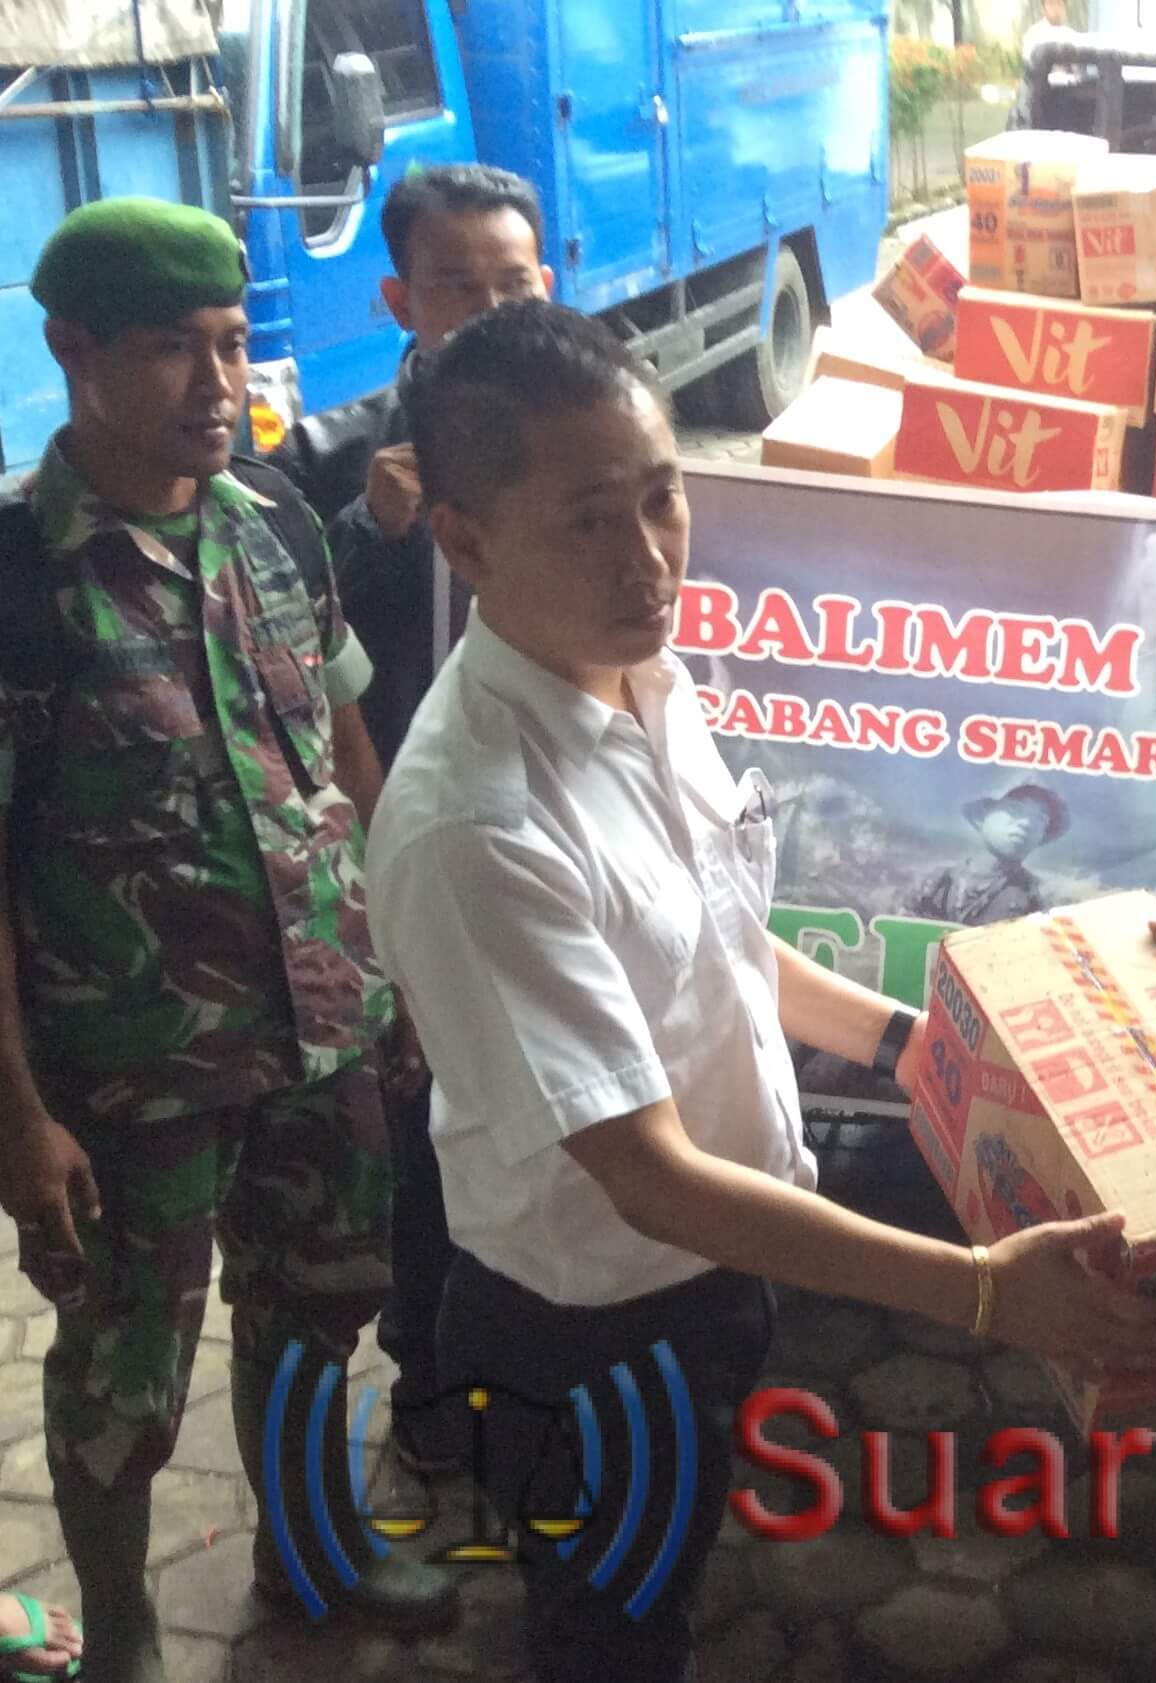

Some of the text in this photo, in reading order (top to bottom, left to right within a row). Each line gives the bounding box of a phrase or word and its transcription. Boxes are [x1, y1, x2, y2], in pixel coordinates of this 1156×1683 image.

[1085, 226, 1124, 255] Vit
[990, 308, 1112, 395] Vit
[935, 396, 1062, 488] Vit
[668, 580, 1142, 695] BALIMEM
[936, 960, 982, 1052] 20030
